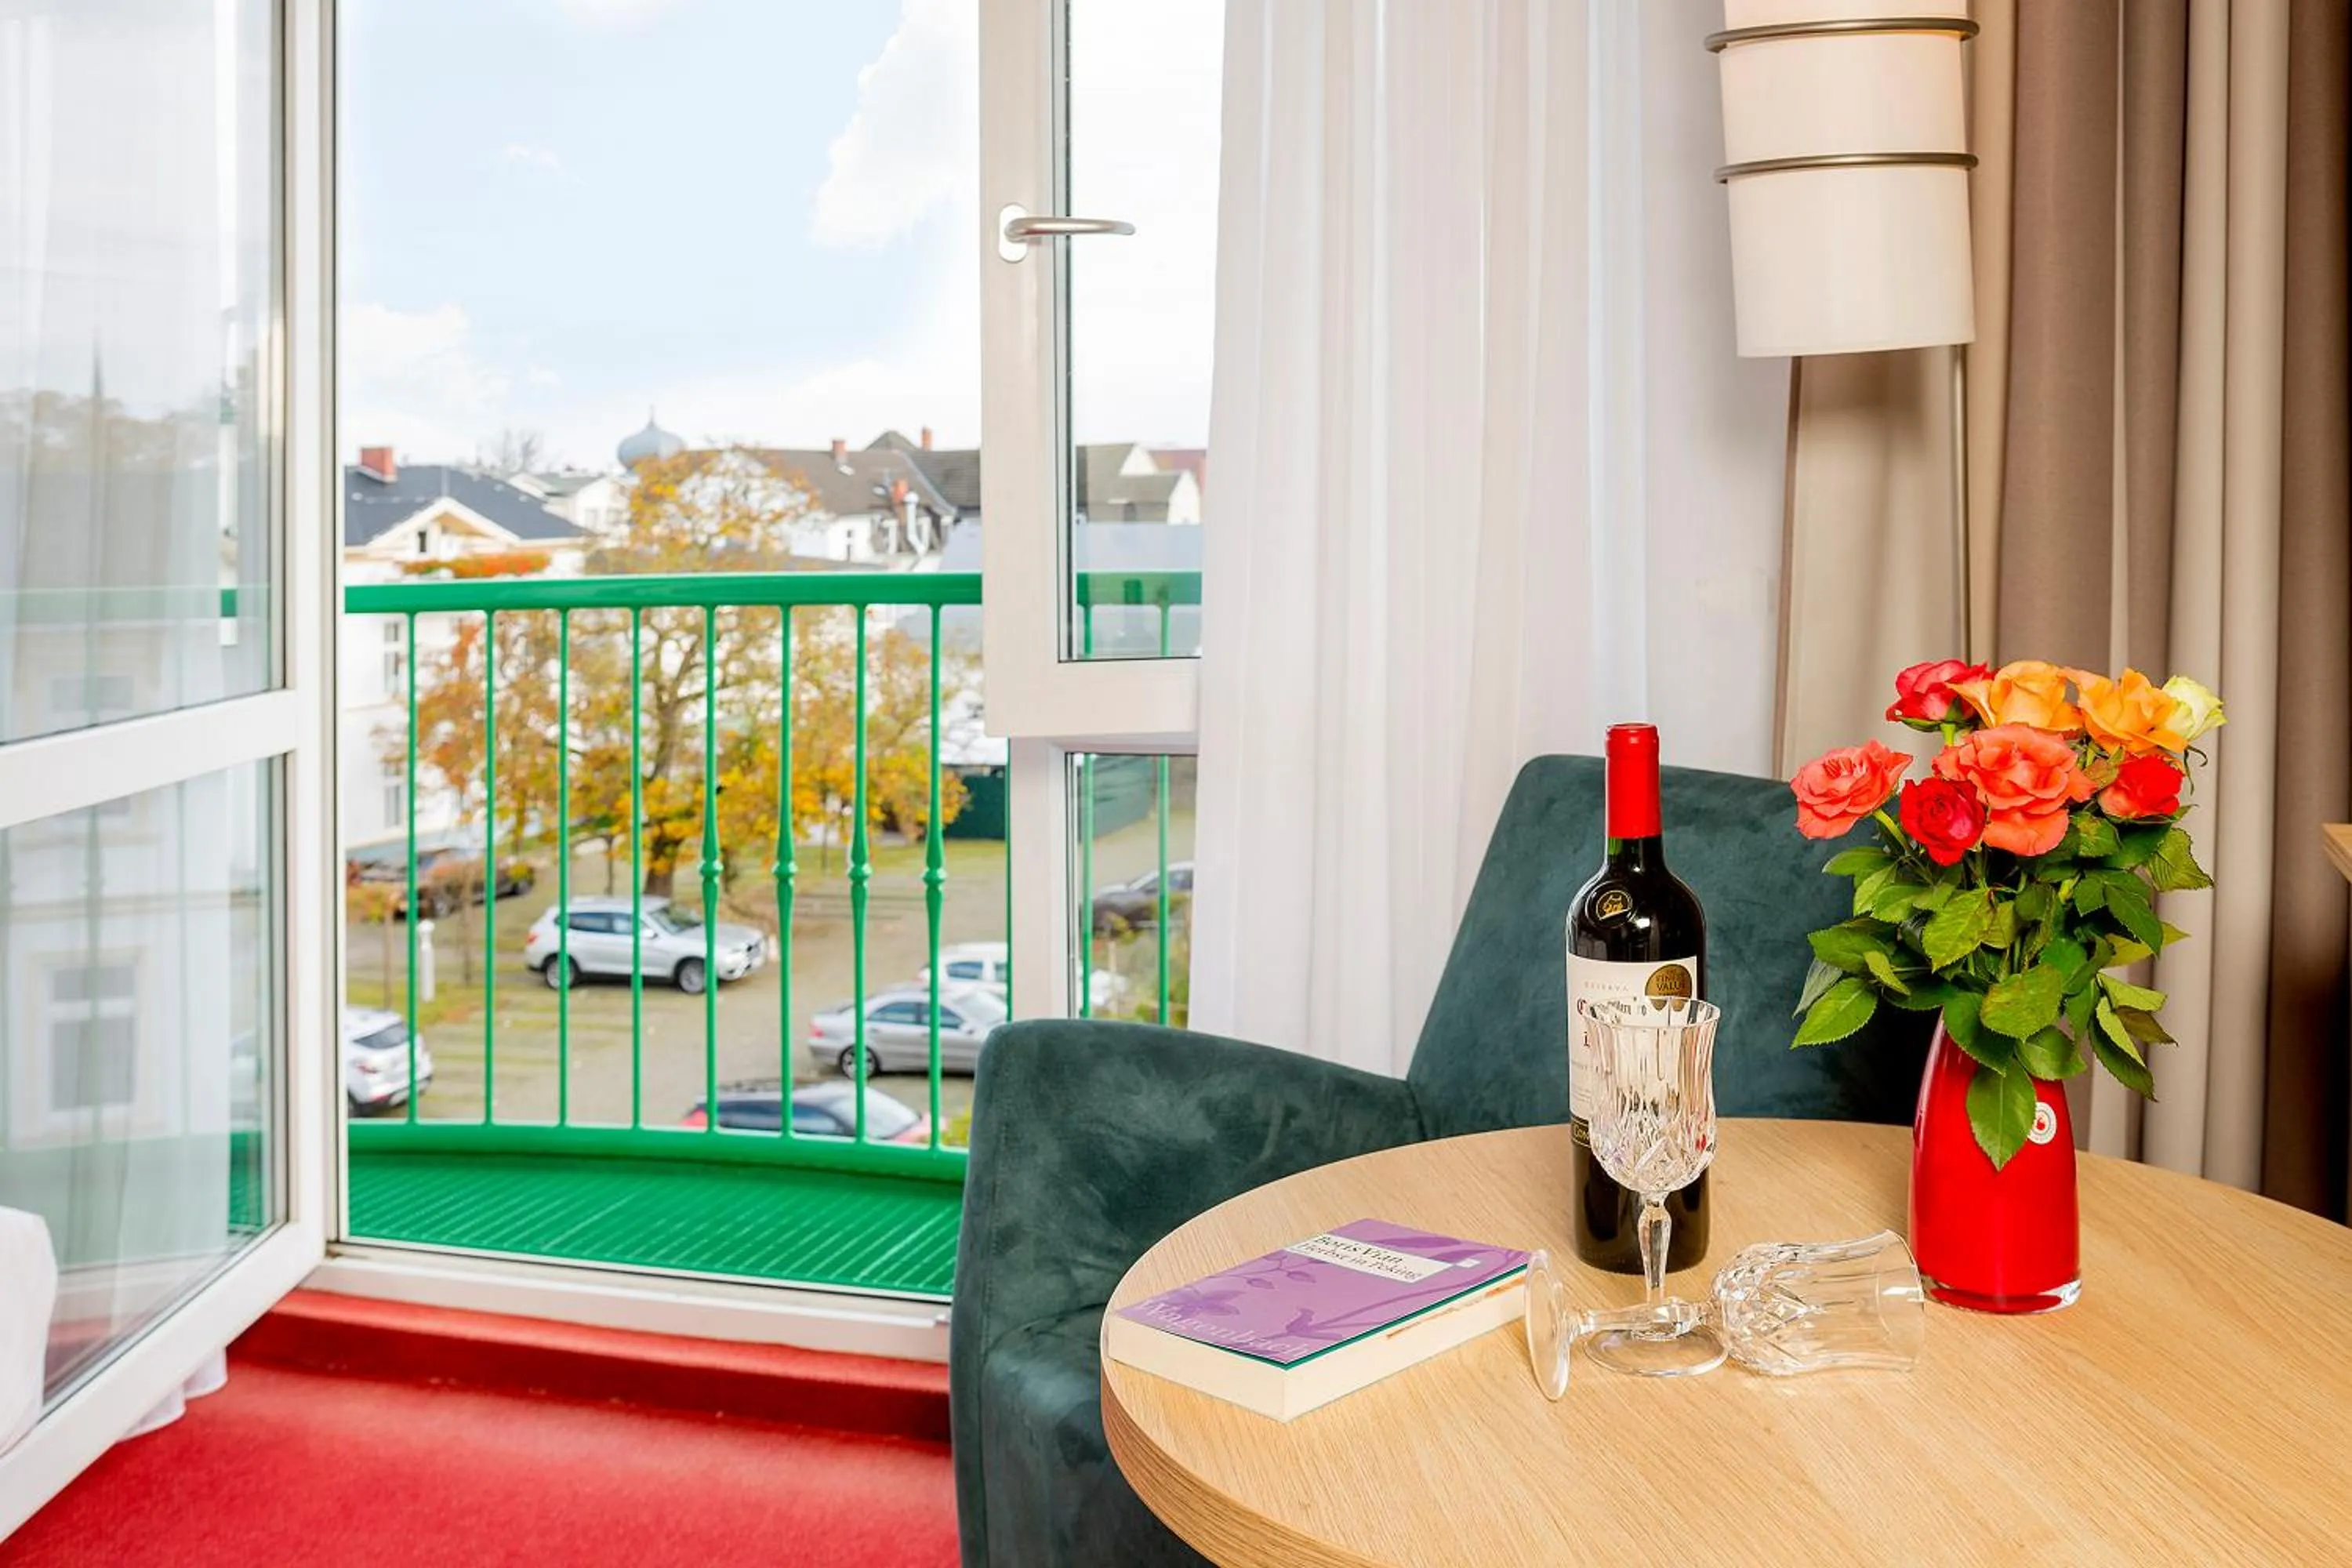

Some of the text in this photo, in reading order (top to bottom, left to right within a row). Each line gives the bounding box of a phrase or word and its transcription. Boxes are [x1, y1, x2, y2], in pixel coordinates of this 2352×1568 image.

[1314, 1235, 1403, 1264] Boris Vian
[1140, 1298, 1311, 1358] Wagenbach
